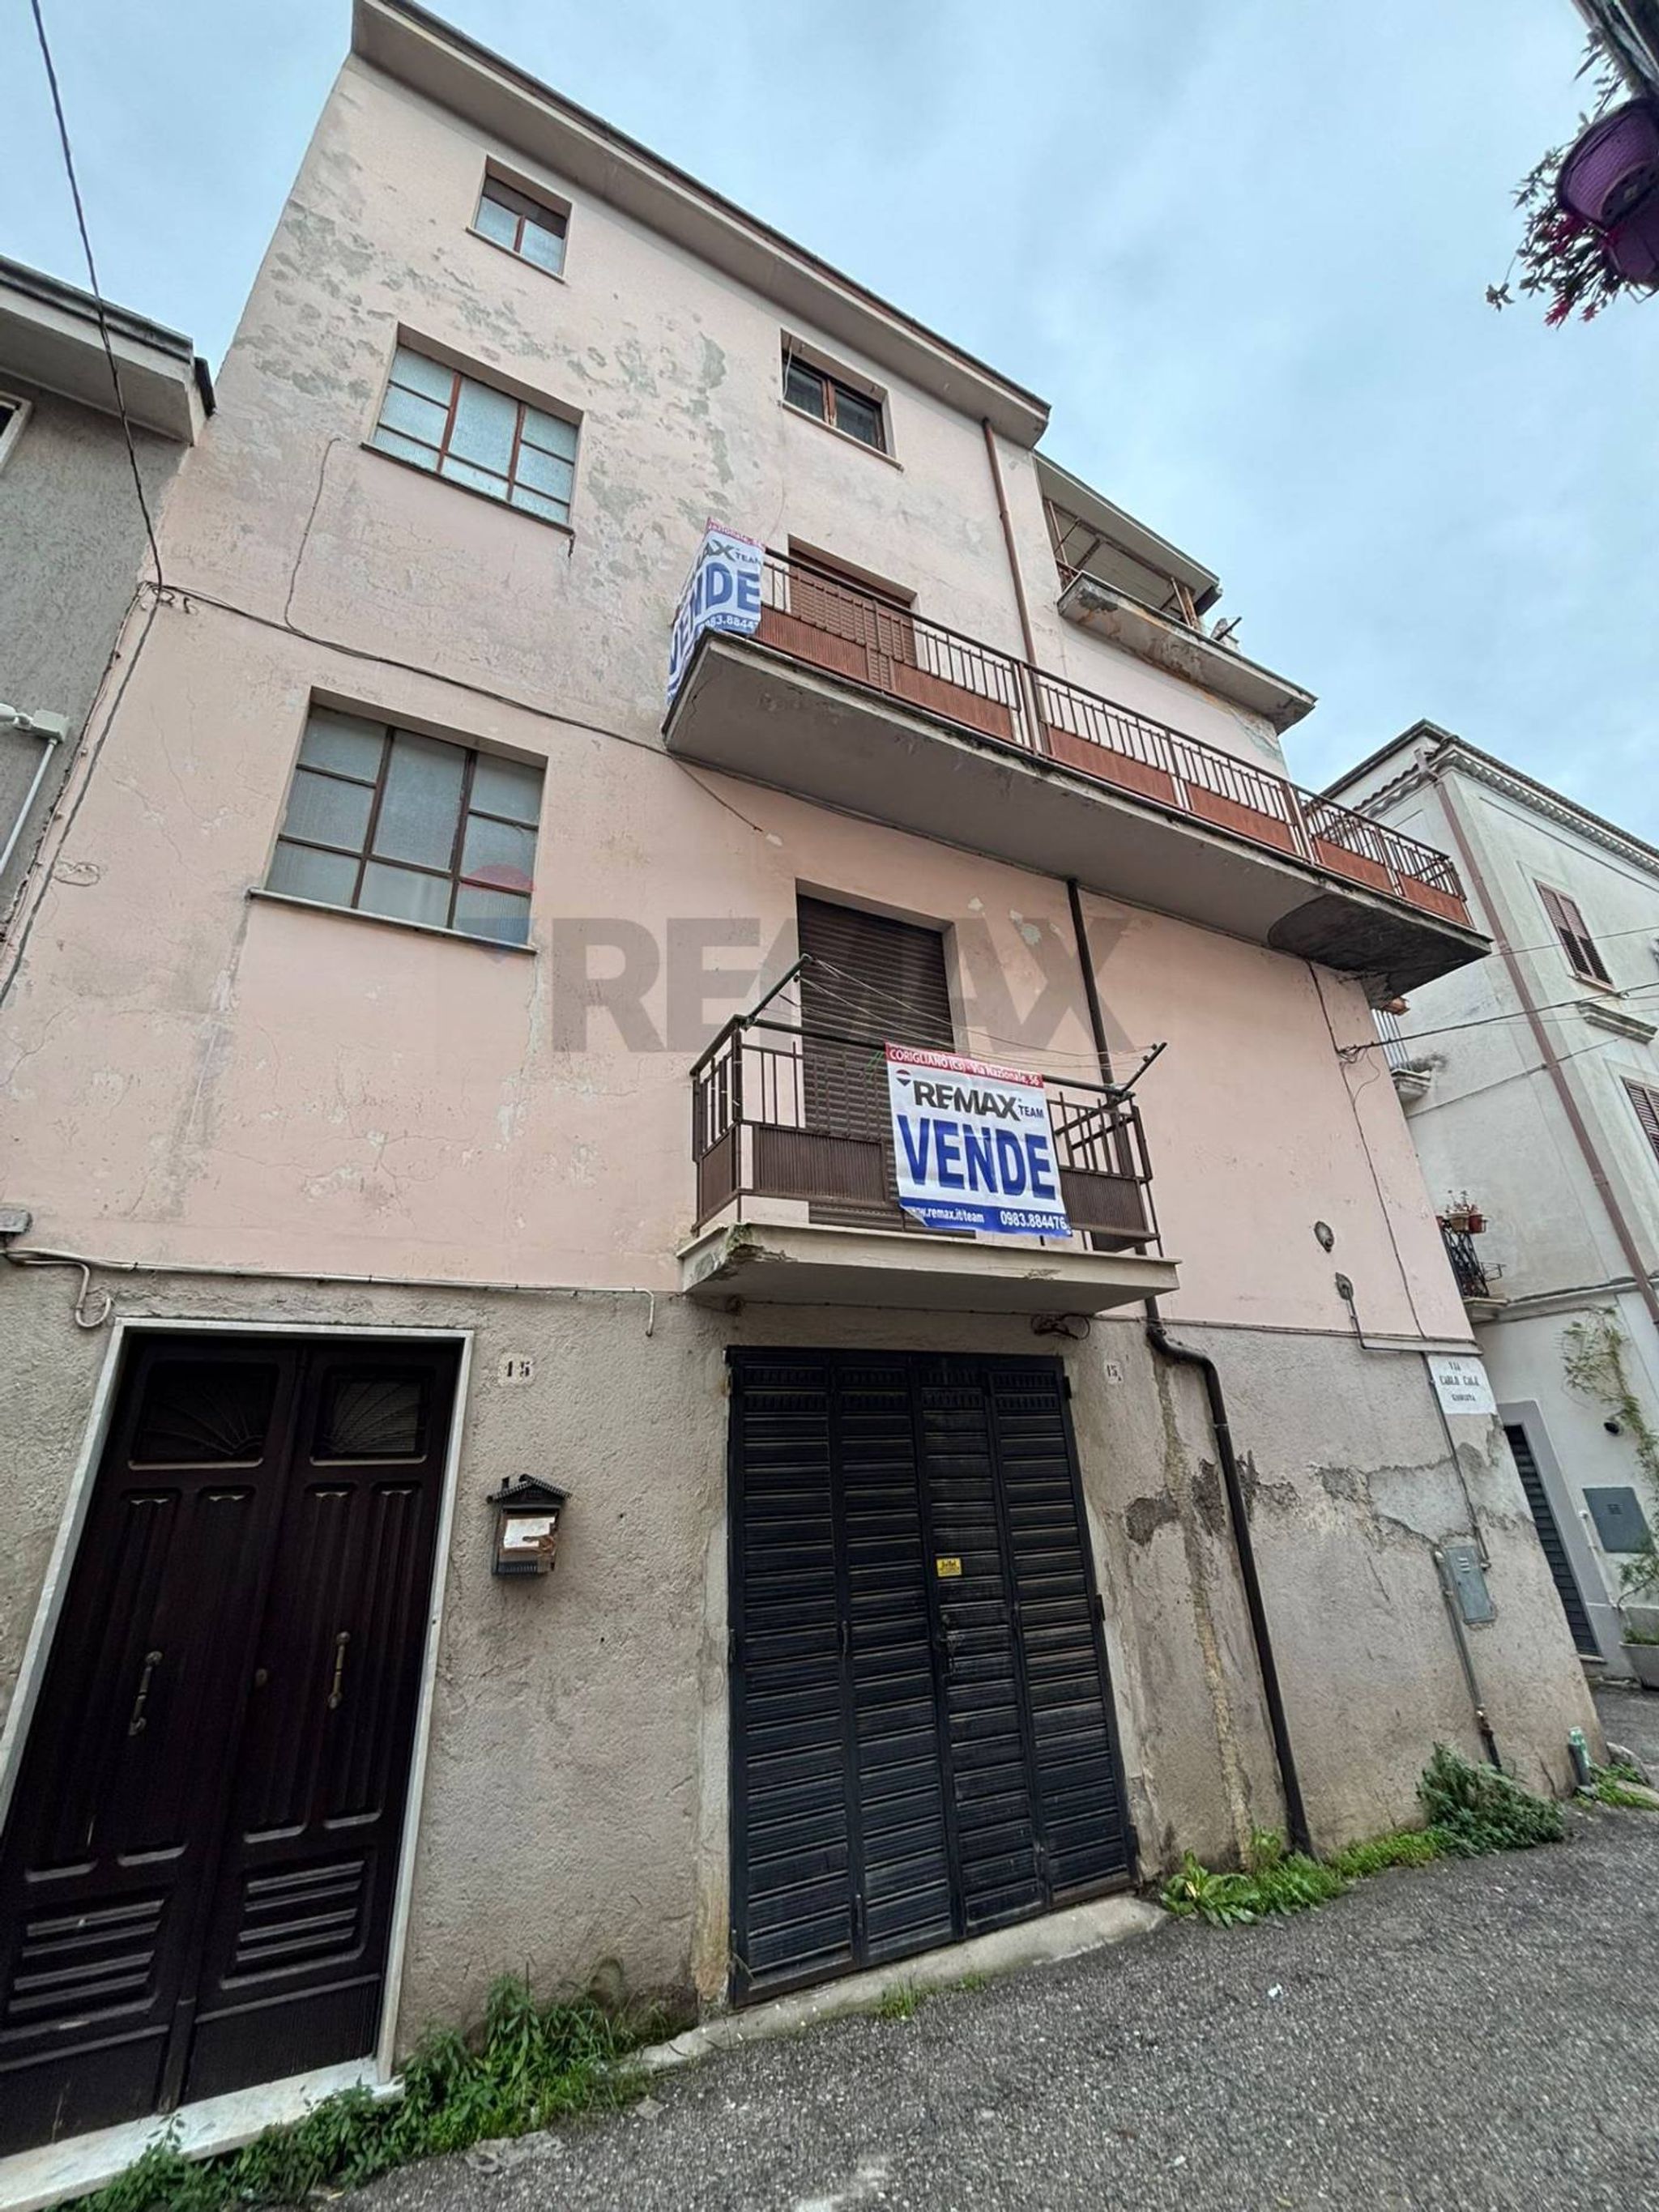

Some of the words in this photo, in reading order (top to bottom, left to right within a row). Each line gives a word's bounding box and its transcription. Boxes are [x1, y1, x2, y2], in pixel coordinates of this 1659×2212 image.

[1018, 1104, 1044, 1119] TEAM
[896, 1114, 1056, 1200] VENDE
[507, 1361, 531, 1378] 15
[1448, 1362, 1461, 1371] VIA
